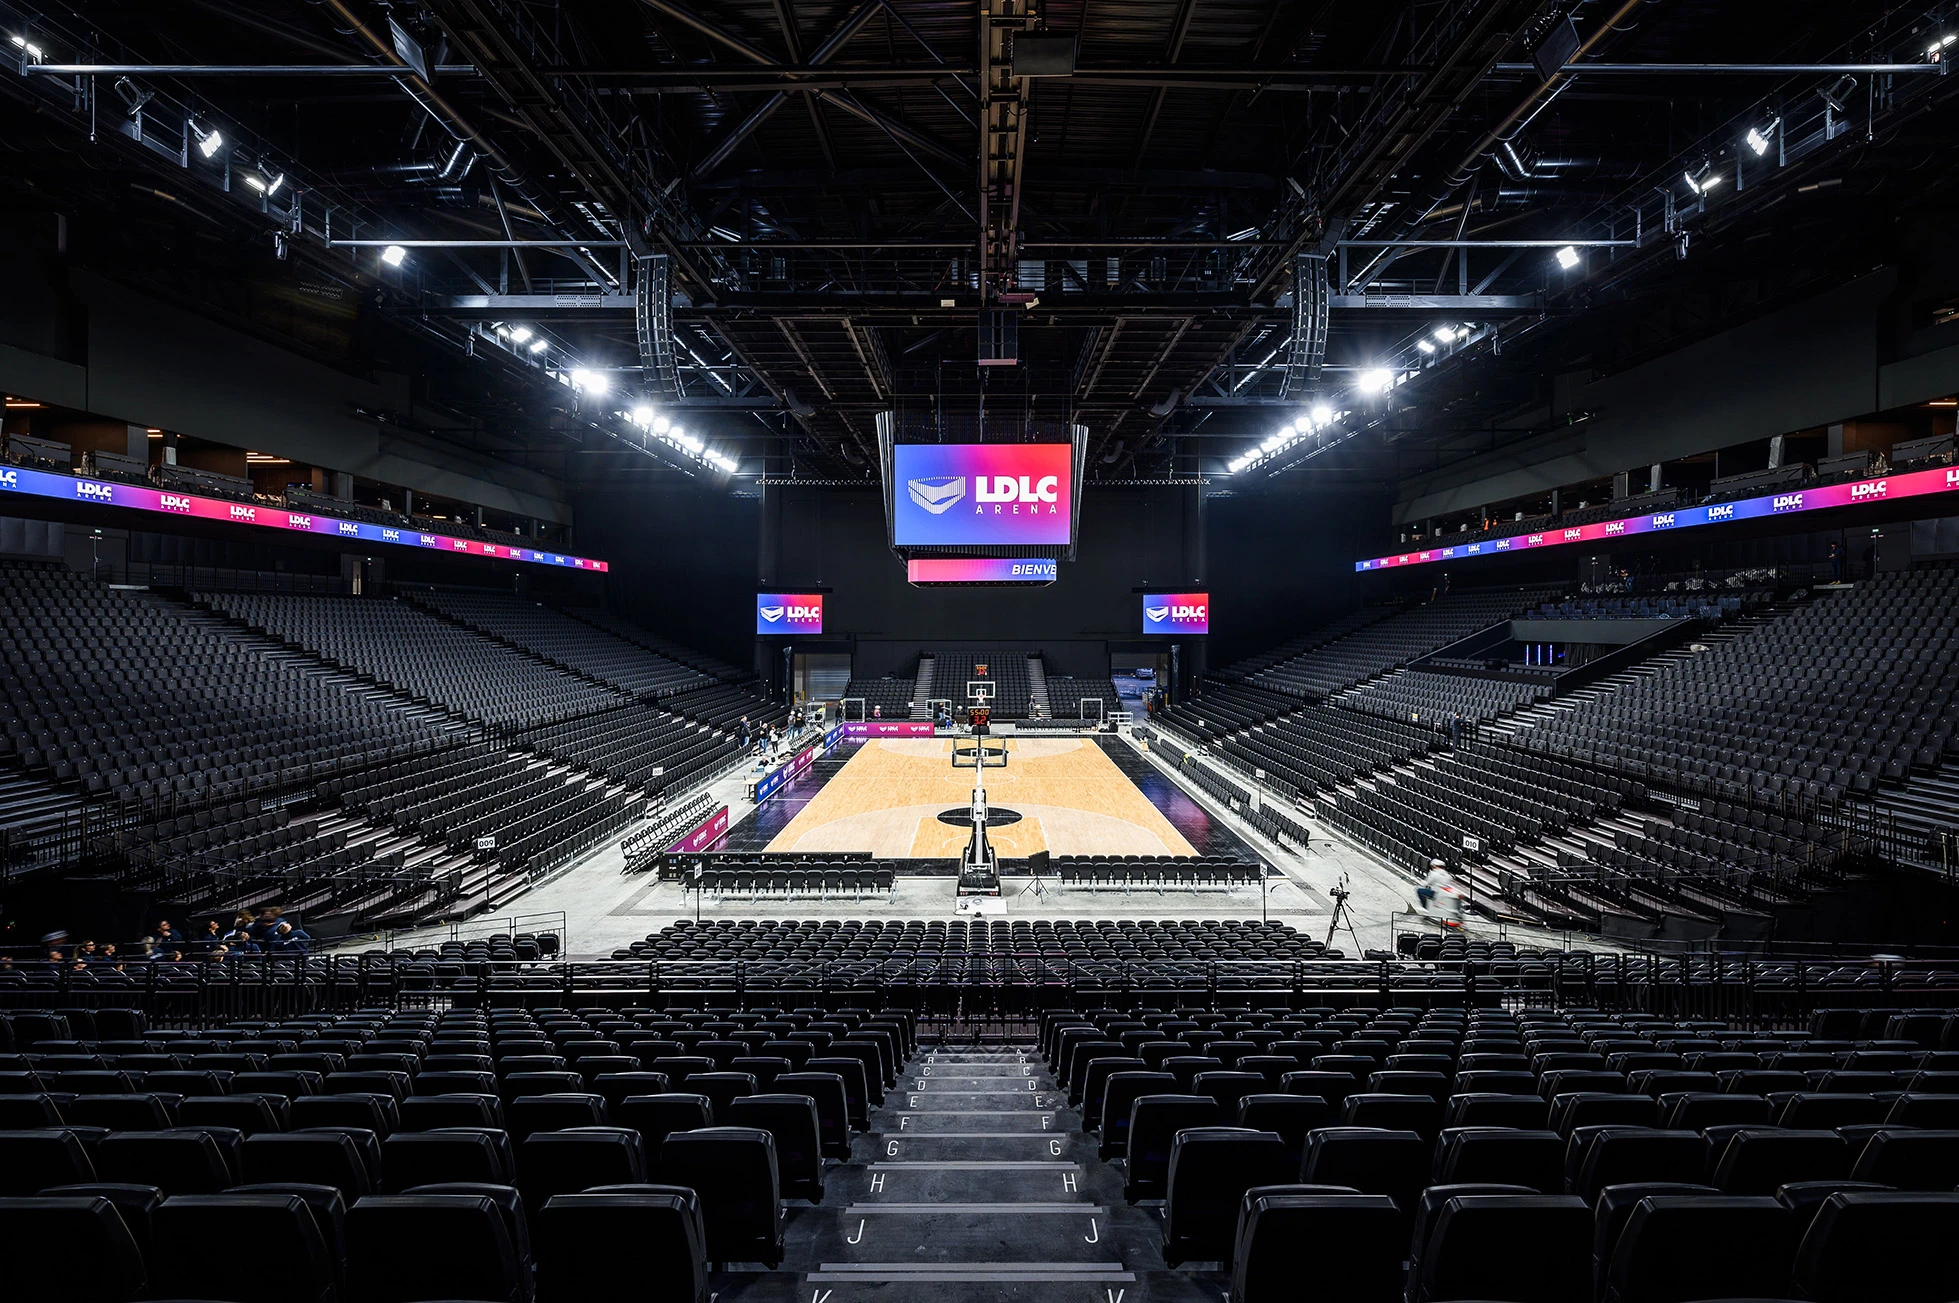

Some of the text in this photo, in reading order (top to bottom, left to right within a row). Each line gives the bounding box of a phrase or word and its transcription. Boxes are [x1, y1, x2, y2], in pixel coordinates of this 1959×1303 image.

[0, 470, 17, 484] LC
[77, 482, 112, 497] LDLC
[975, 475, 1058, 503] LDLC
[1851, 481, 1887, 496] LDLC
[161, 495, 190, 509] LDLC
[1773, 494, 1803, 508] LDLC
[230, 505, 255, 518] LDLC
[975, 504, 1057, 514] ARENA
[1708, 505, 1733, 517] LDLC
[289, 515, 311, 526] LDLC
[1653, 514, 1675, 525] LDLC
[340, 522, 358, 533] LDLC
[1605, 522, 1625, 532] LDLC
[1564, 529, 1581, 538] LDLC
[1011, 564, 1057, 575] BIENVE
[786, 606, 820, 618] LDLC
[1172, 605, 1206, 618] LDLC
[1465, 840, 1477, 848] 010
[923, 1067, 931, 1076] C
[1022, 1067, 1031, 1076] C
[917, 1080, 926, 1091] D
[1028, 1080, 1037, 1091] D
[909, 1096, 919, 1108] E
[1035, 1096, 1044, 1108] E
[900, 1117, 910, 1130] F
[1042, 1116, 1050, 1130] F
[887, 1140, 899, 1156] G
[1049, 1140, 1061, 1156] G
[870, 1173, 885, 1193] H
[1062, 1173, 1077, 1193] H
[847, 1219, 865, 1244] J
[1084, 1218, 1099, 1244] J
